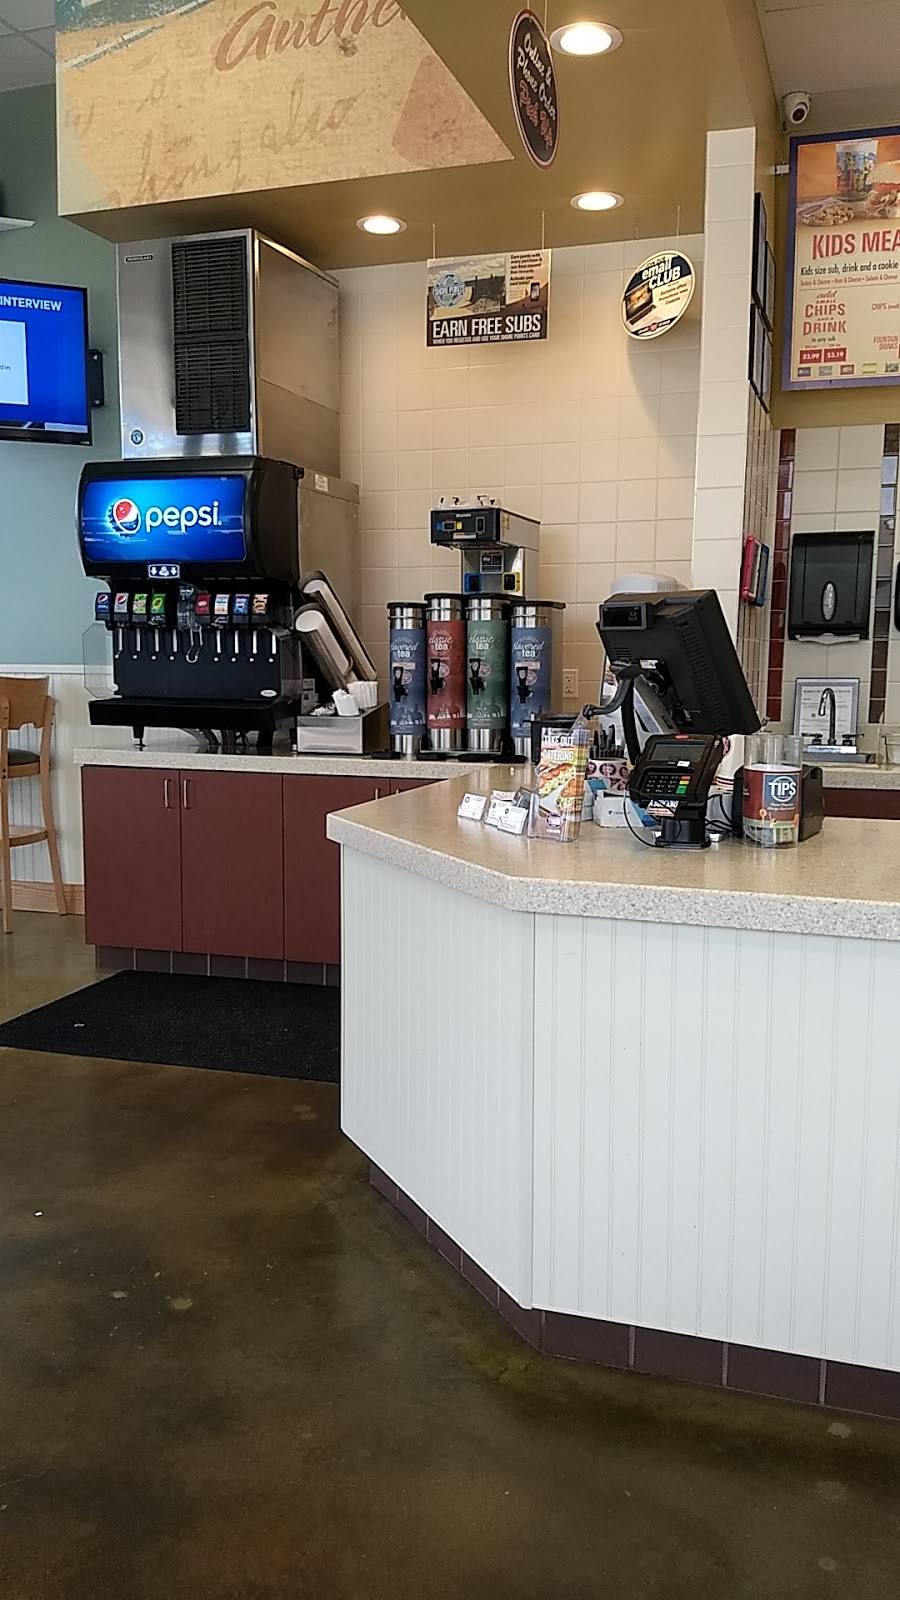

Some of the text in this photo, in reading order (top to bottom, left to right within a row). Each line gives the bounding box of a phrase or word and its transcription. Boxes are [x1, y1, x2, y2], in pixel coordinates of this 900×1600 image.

[524, 33, 545, 76] Online
[517, 46, 556, 121] Phone Order
[812, 233, 856, 260] KIDS
[642, 258, 672, 280] email
[800, 265, 813, 275] Kids
[815, 265, 827, 275] size
[842, 262, 858, 273] drink
[860, 260, 872, 271] and
[878, 259, 898, 270] cookie
[649, 266, 680, 289] CLUB
[0, 296, 62, 312] INTERVIEW
[805, 303, 846, 318] CHIPS
[433, 314, 541, 338] EARN FREE SUBS
[803, 319, 847, 335] DRINK
[145, 501, 219, 532] pepsi
[428, 633, 453, 645] classic
[434, 641, 448, 651] tea
[468, 633, 494, 645] classic
[475, 641, 489, 651] tea
[397, 649, 411, 658] tea
[522, 649, 536, 658] tea
[768, 782, 797, 796] TIPS
